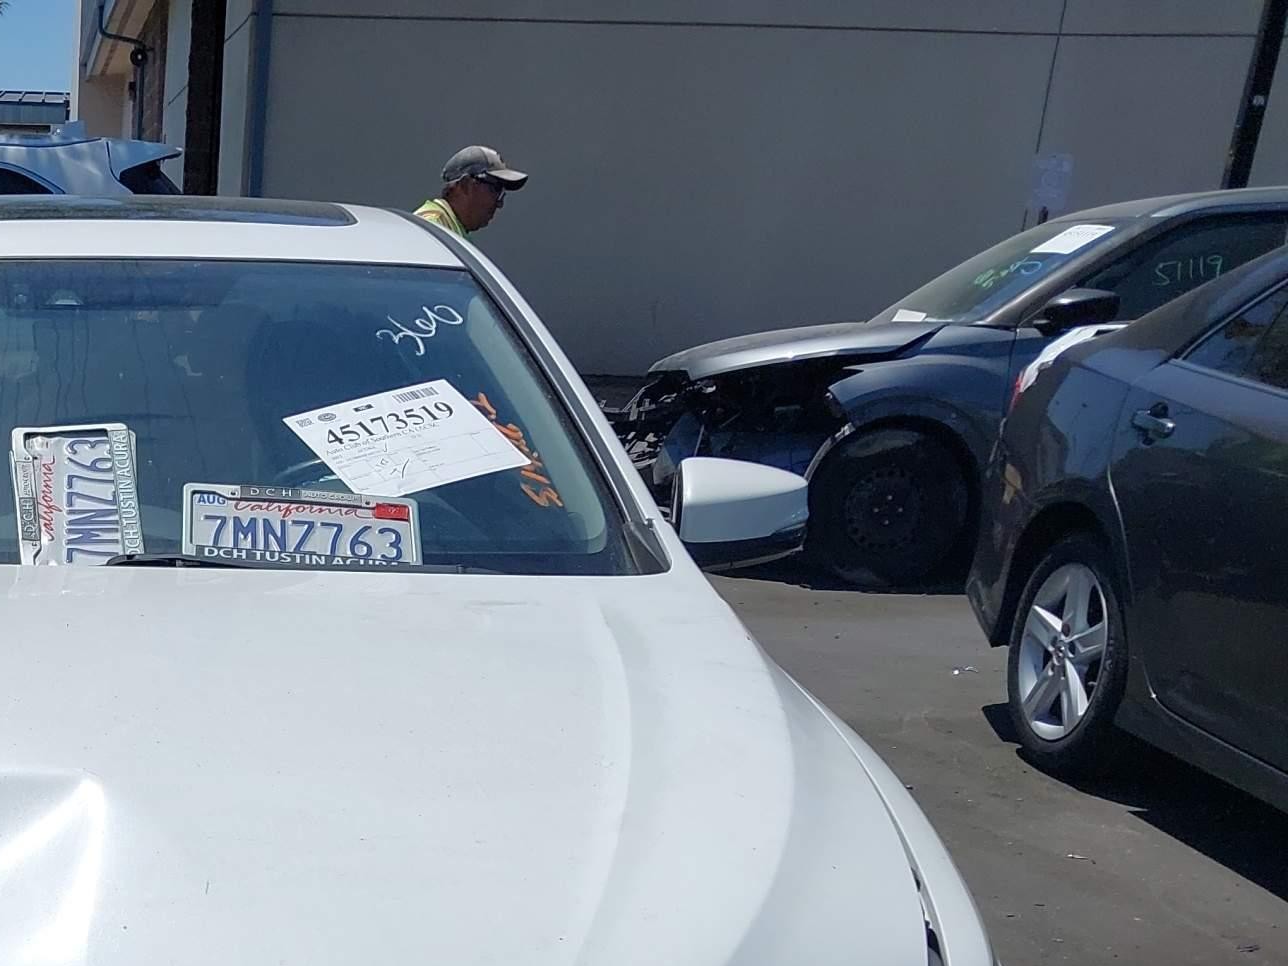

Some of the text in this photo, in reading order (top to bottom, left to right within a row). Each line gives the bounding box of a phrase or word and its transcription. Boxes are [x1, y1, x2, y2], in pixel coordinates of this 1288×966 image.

[327, 402, 454, 445] 45173519
[114, 435, 131, 477] ACURA
[64, 438, 120, 564] 7MNZ763
[119, 478, 136, 526] TUSTIN
[196, 493, 226, 505] AUG
[233, 501, 373, 519] California
[202, 515, 403, 562] 7MNZ763
[204, 547, 399, 566] DCH TUSTIN ACU
